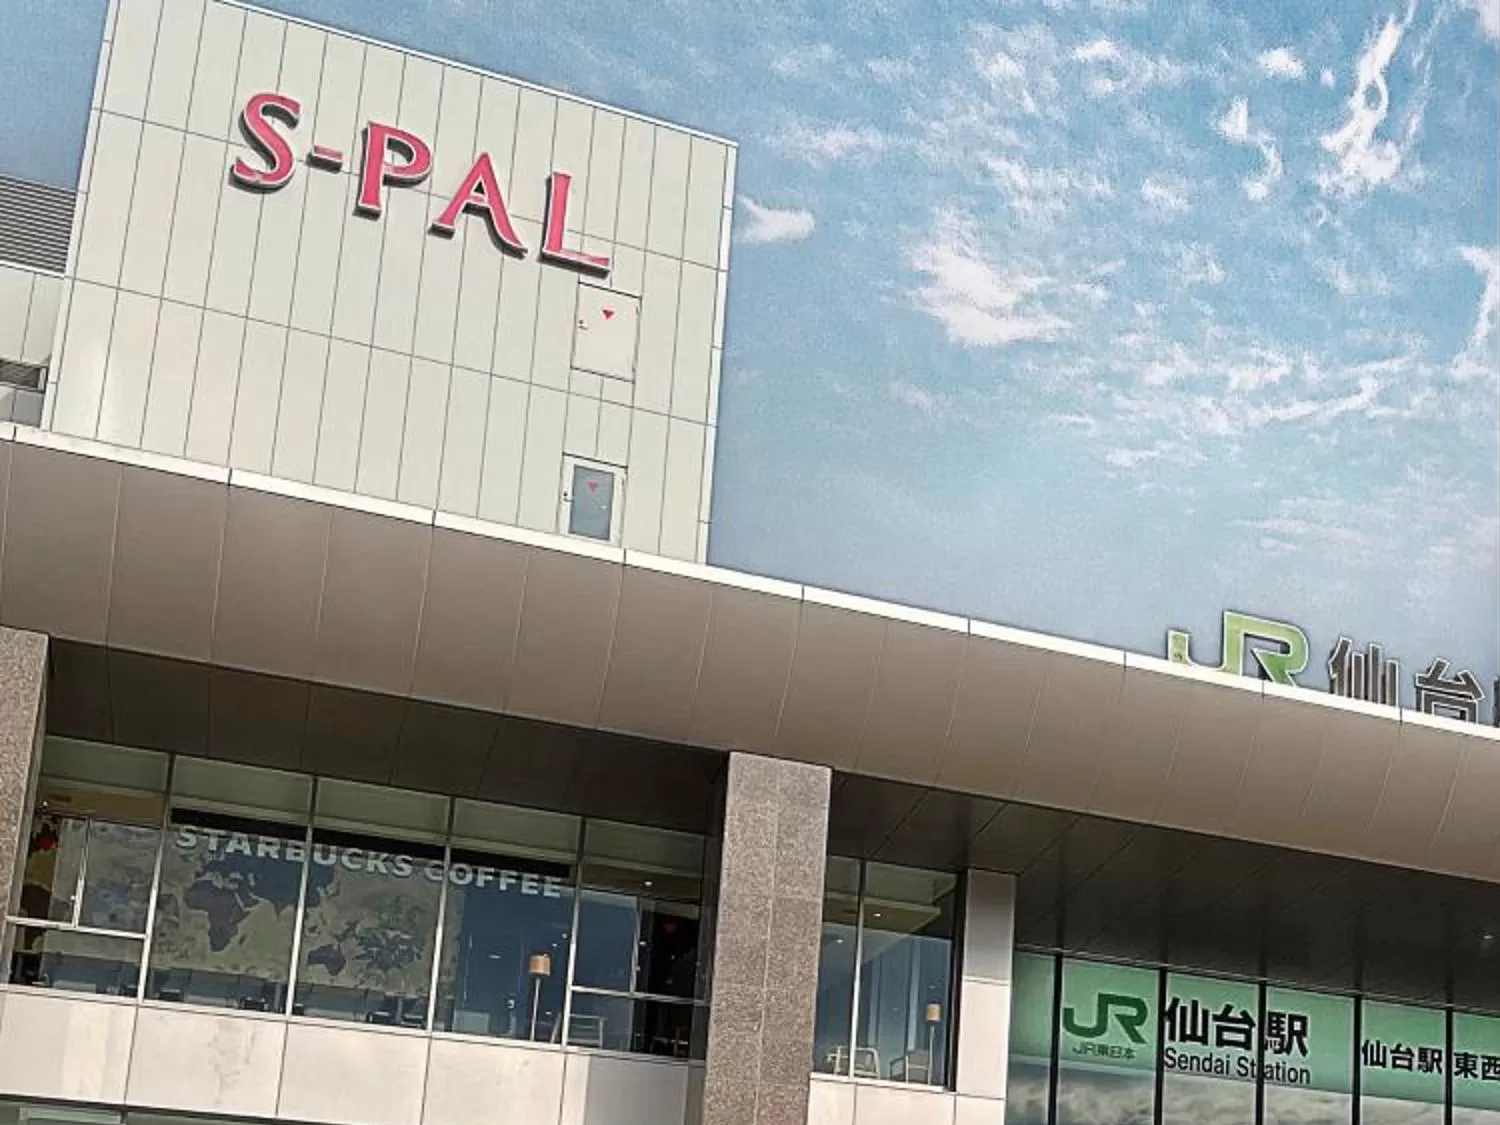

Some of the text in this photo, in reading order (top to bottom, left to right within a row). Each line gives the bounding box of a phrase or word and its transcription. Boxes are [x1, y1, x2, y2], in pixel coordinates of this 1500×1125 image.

[229, 92, 612, 278] S-PAL
[176, 824, 562, 898] STARBUCKS COFFEE
[1063, 991, 1310, 1058] JR 仙台駅
[1164, 1047, 1312, 1086] Sendai Station
